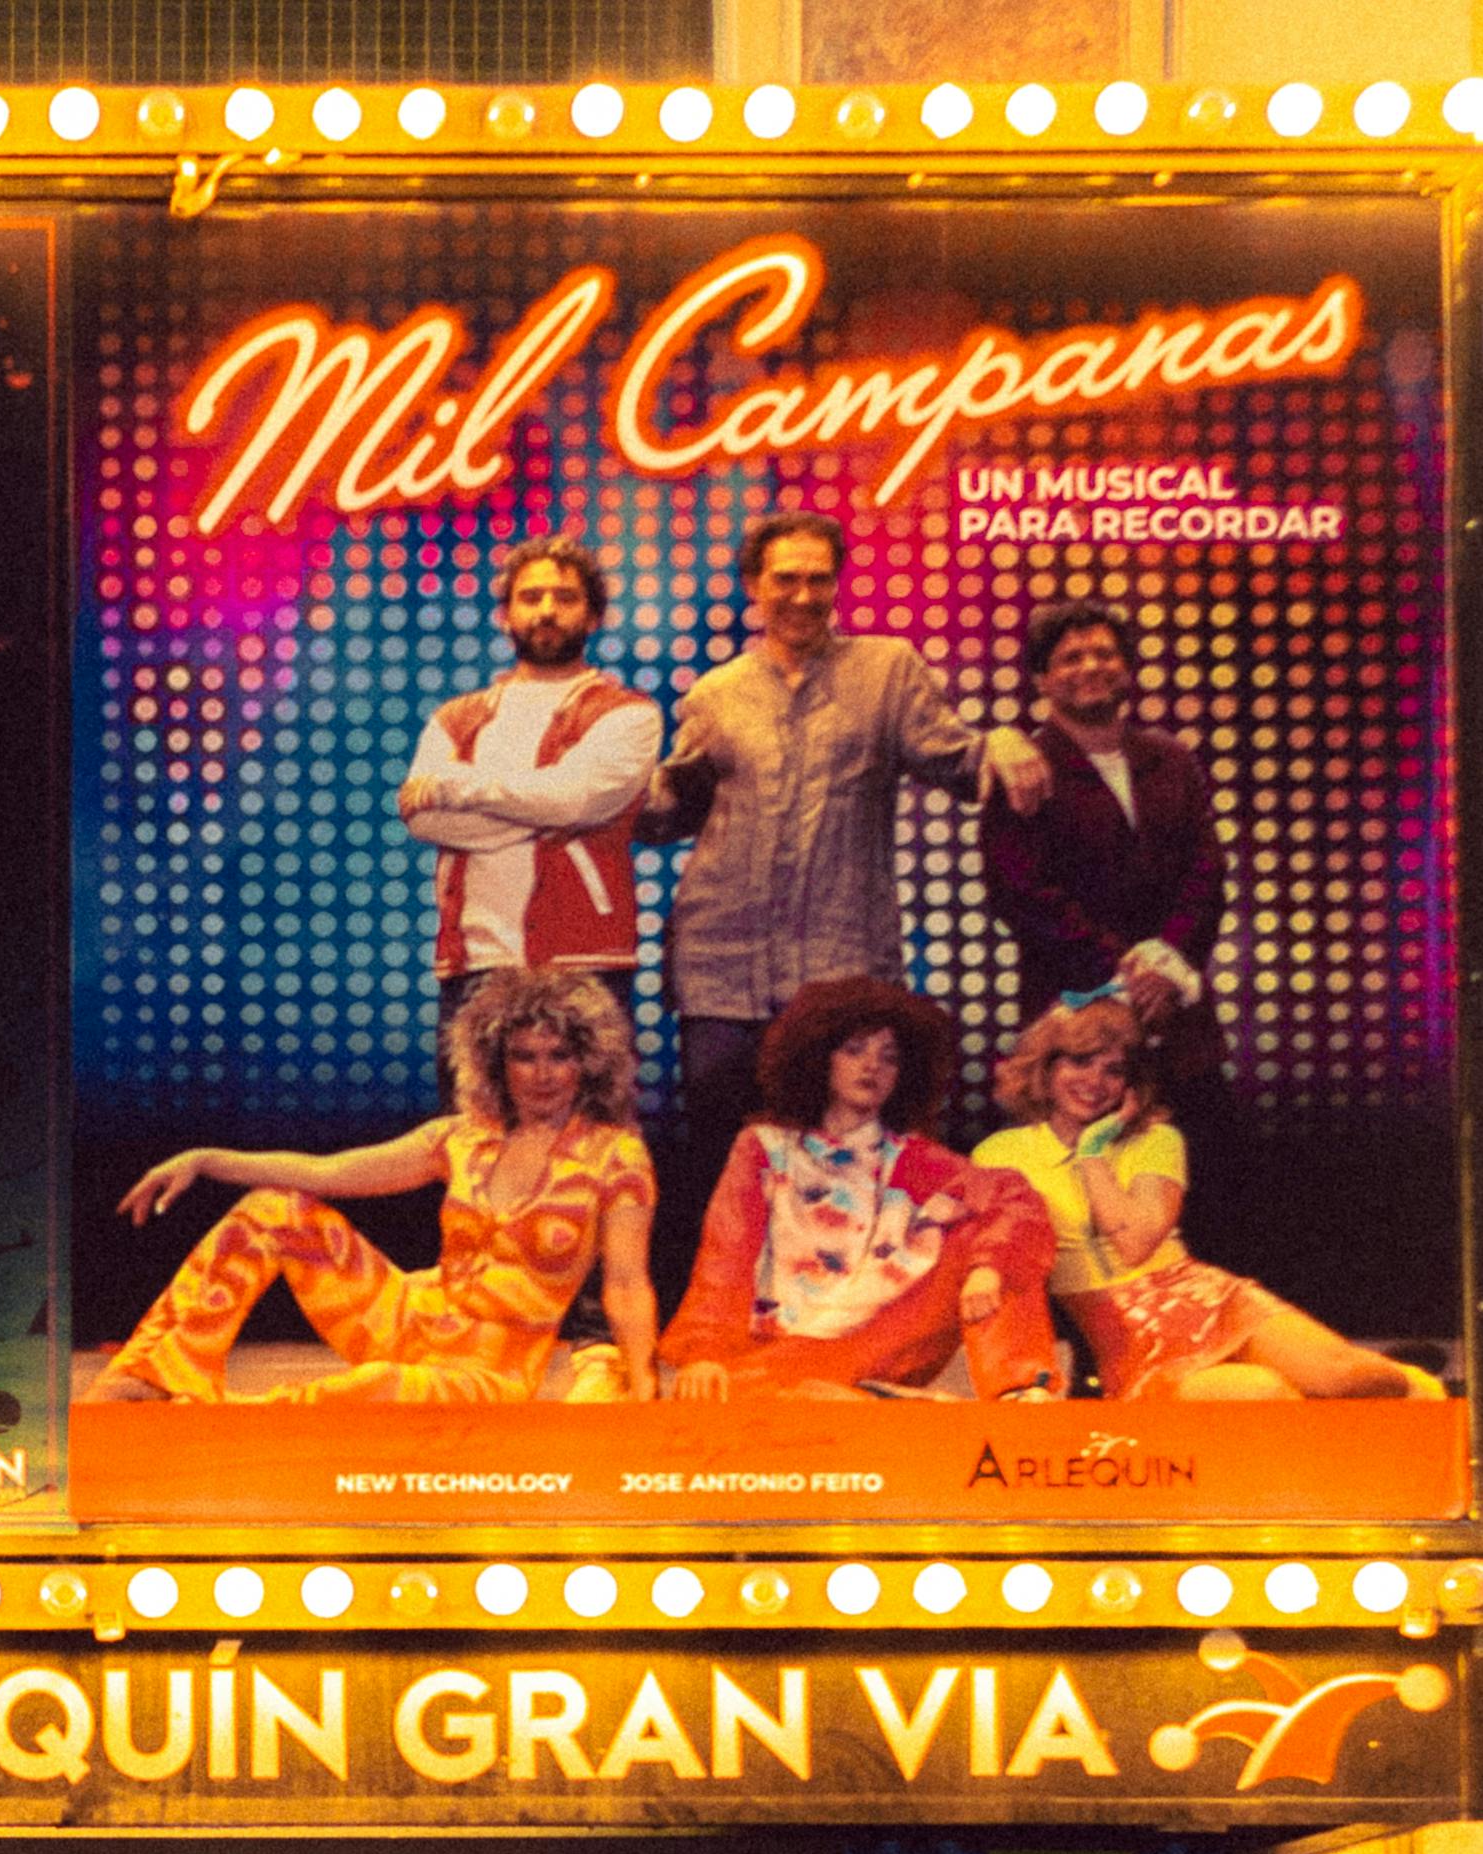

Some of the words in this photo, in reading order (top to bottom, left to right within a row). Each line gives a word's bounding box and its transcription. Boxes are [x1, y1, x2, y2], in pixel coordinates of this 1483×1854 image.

[186, 276, 602, 534] Mil
[617, 251, 1349, 507] Campanas
[959, 467, 1022, 501] UN
[1035, 466, 1237, 501] MUSICAL
[959, 506, 1082, 541] PARA
[1091, 506, 1344, 541] RECORDAR
[335, 1474, 395, 1493] NEW
[401, 1473, 572, 1493] TECHNOLOGY
[620, 1473, 684, 1493] JOSE
[690, 1473, 806, 1493] ANTONIO
[811, 1473, 884, 1493] FEITO
[967, 1440, 1195, 1489] ARLEQUIN
[392, 1666, 814, 1784] GRAN
[853, 1665, 1119, 1783] VIA
